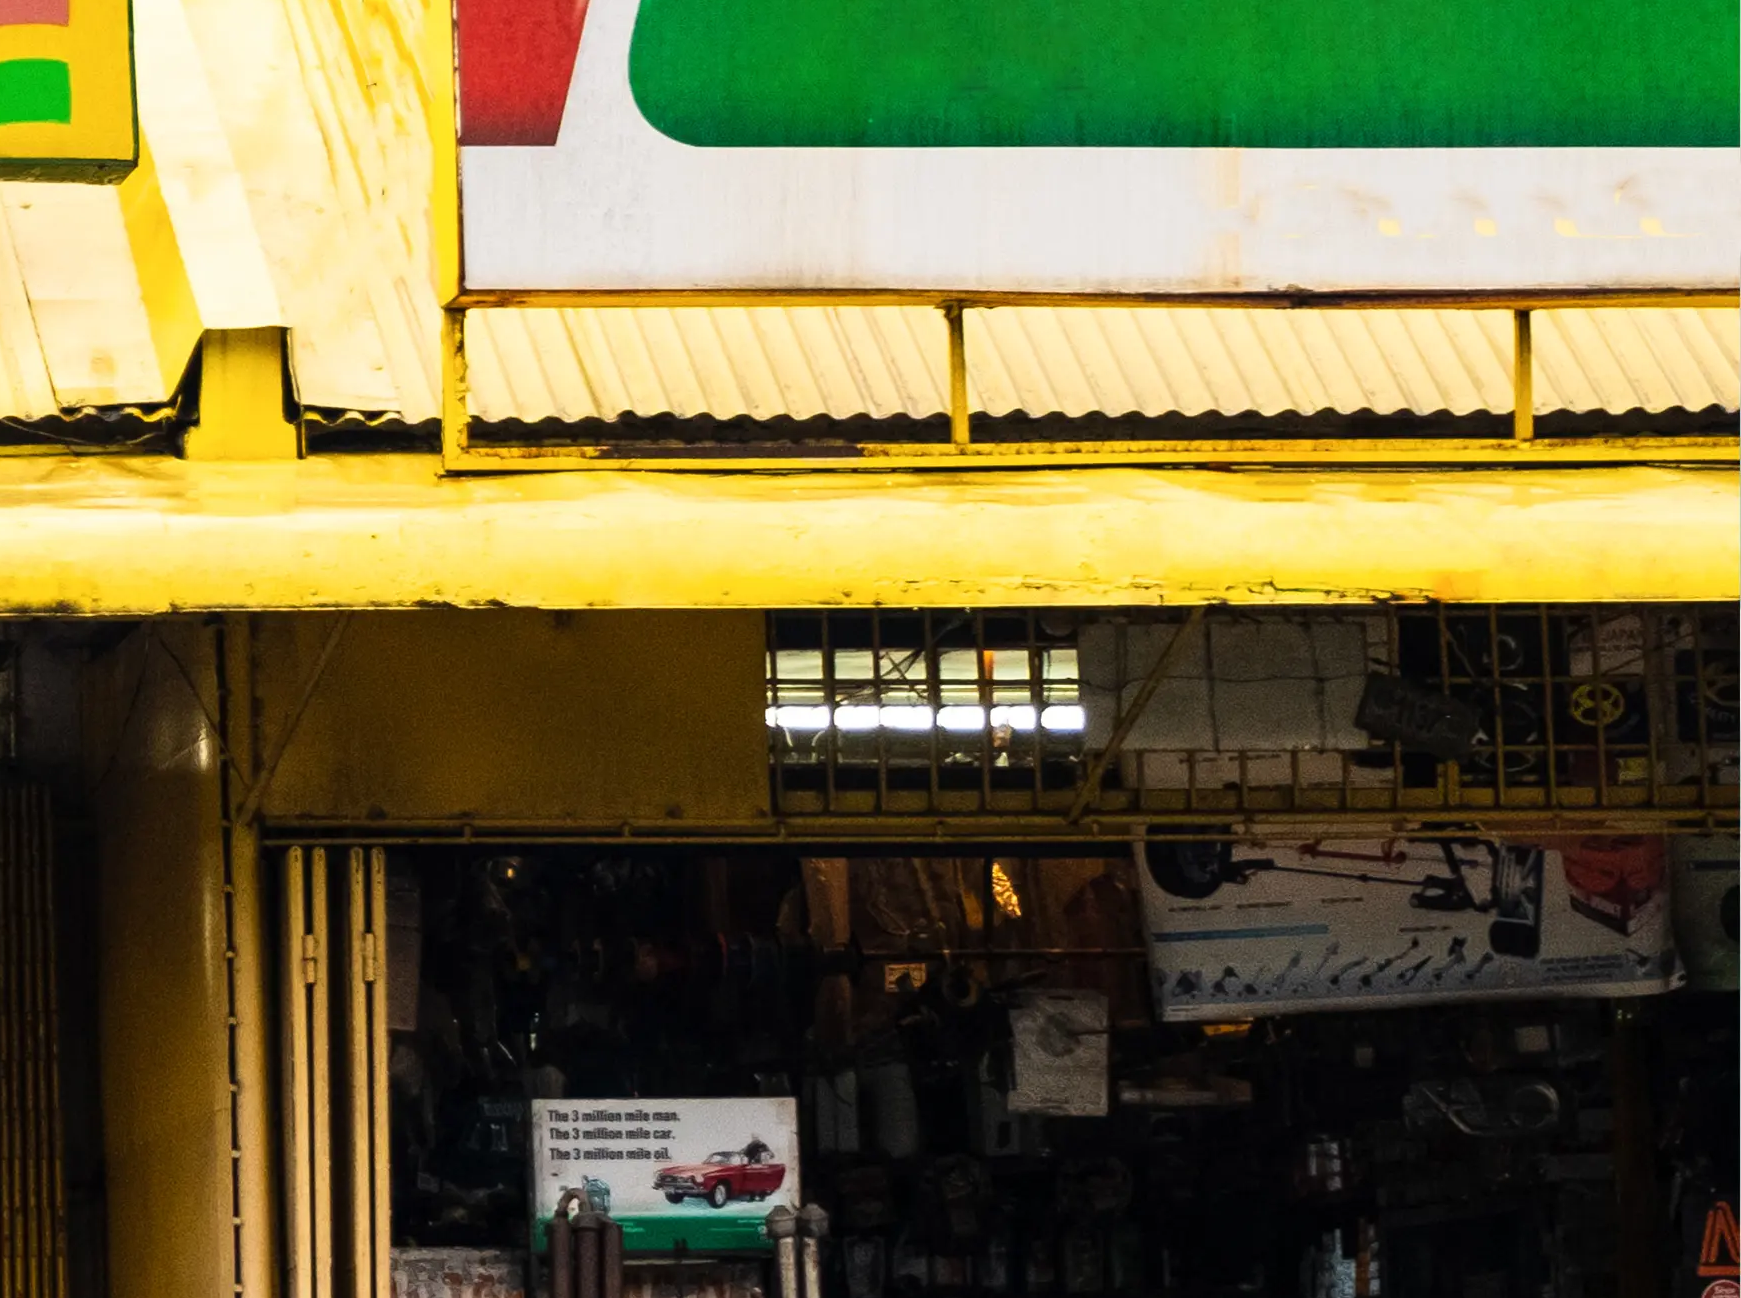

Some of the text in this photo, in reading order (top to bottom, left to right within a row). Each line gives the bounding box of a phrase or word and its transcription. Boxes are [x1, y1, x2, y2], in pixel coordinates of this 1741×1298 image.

[548, 1110, 568, 1122] The
[572, 1110, 579, 1122] 3
[582, 1110, 621, 1122] million
[625, 1110, 649, 1122] mile
[550, 1128, 569, 1140] The
[573, 1128, 580, 1140] 3
[583, 1128, 623, 1140] million
[626, 1128, 649, 1140] mile
[550, 1148, 570, 1160] The
[574, 1148, 581, 1160] 3
[583, 1148, 624, 1160] million
[627, 1148, 651, 1160] mile
